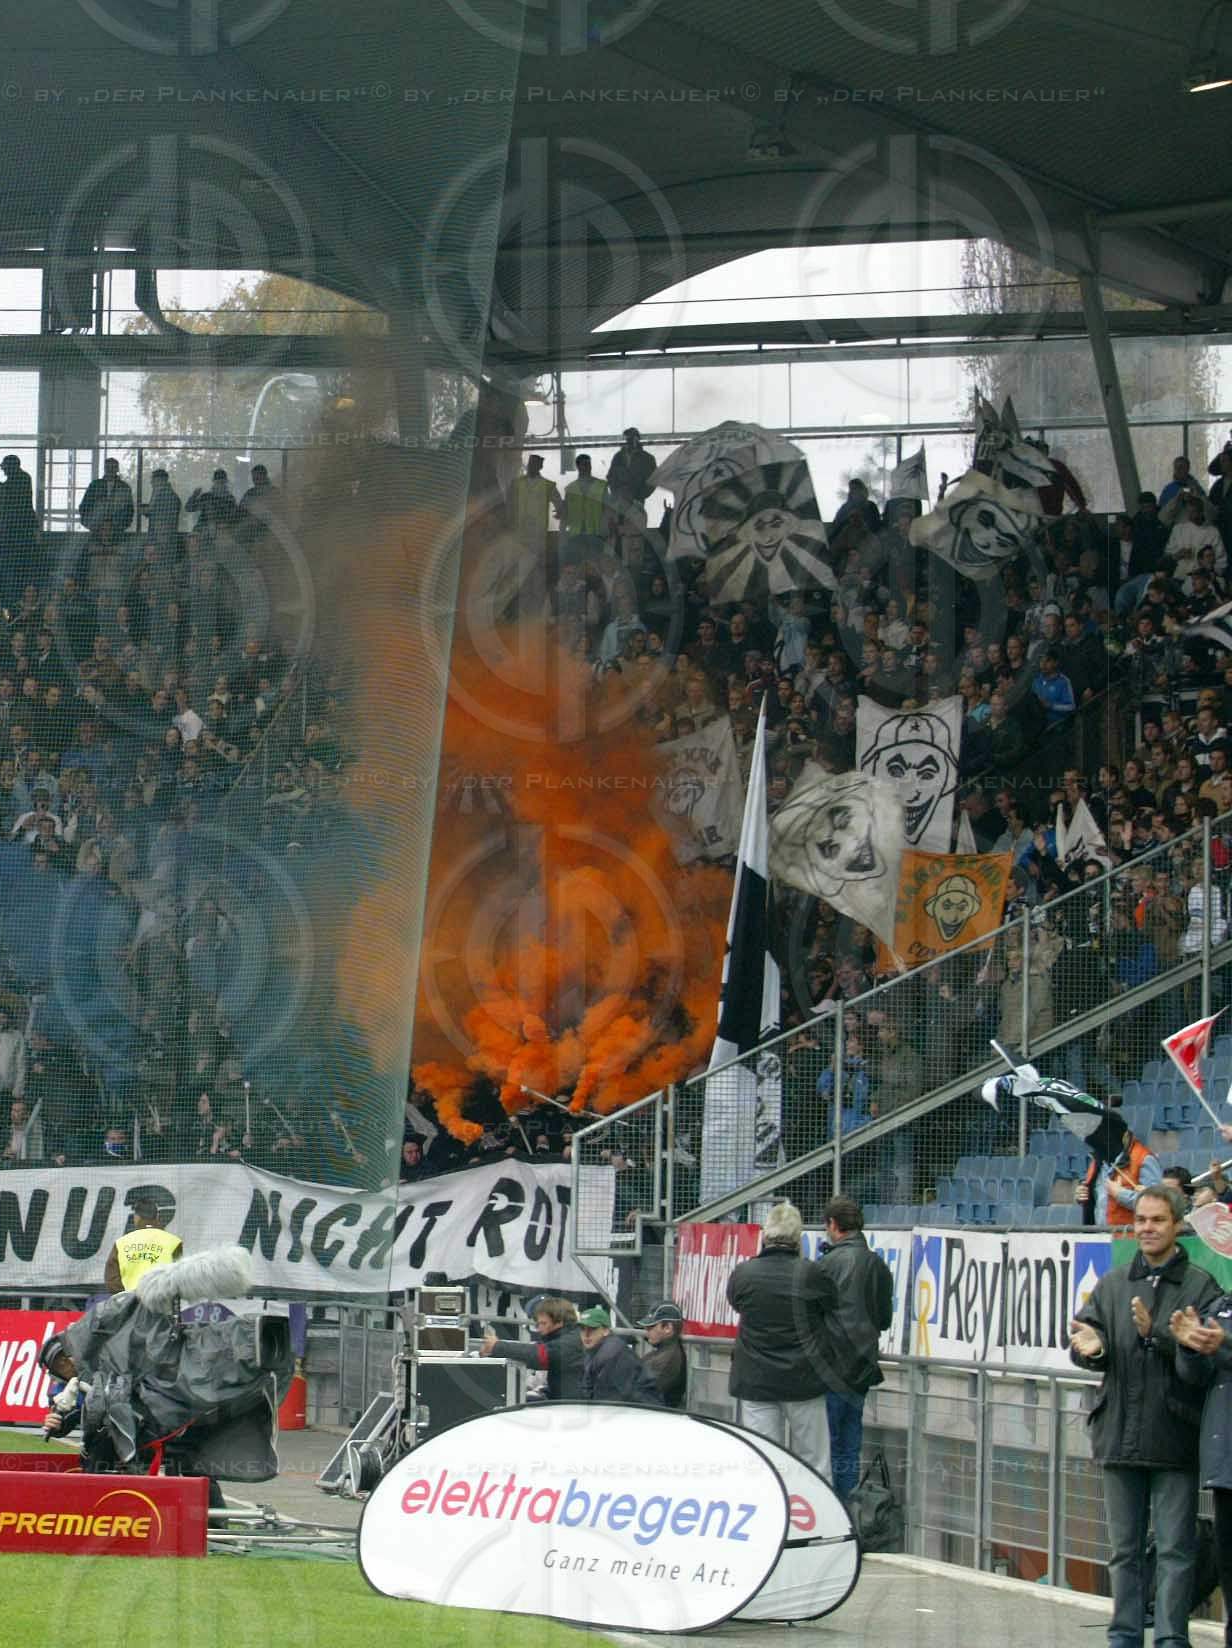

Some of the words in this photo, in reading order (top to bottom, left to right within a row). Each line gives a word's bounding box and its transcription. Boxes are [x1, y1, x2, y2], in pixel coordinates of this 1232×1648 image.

[238, 1187, 453, 1271] NICHT
[939, 1237, 1072, 1363] Reyhani
[400, 1469, 758, 1546] elektrabregenz
[543, 1549, 599, 1573] Ganz
[609, 1558, 681, 1581] meine
[692, 1563, 737, 1588] Art.
